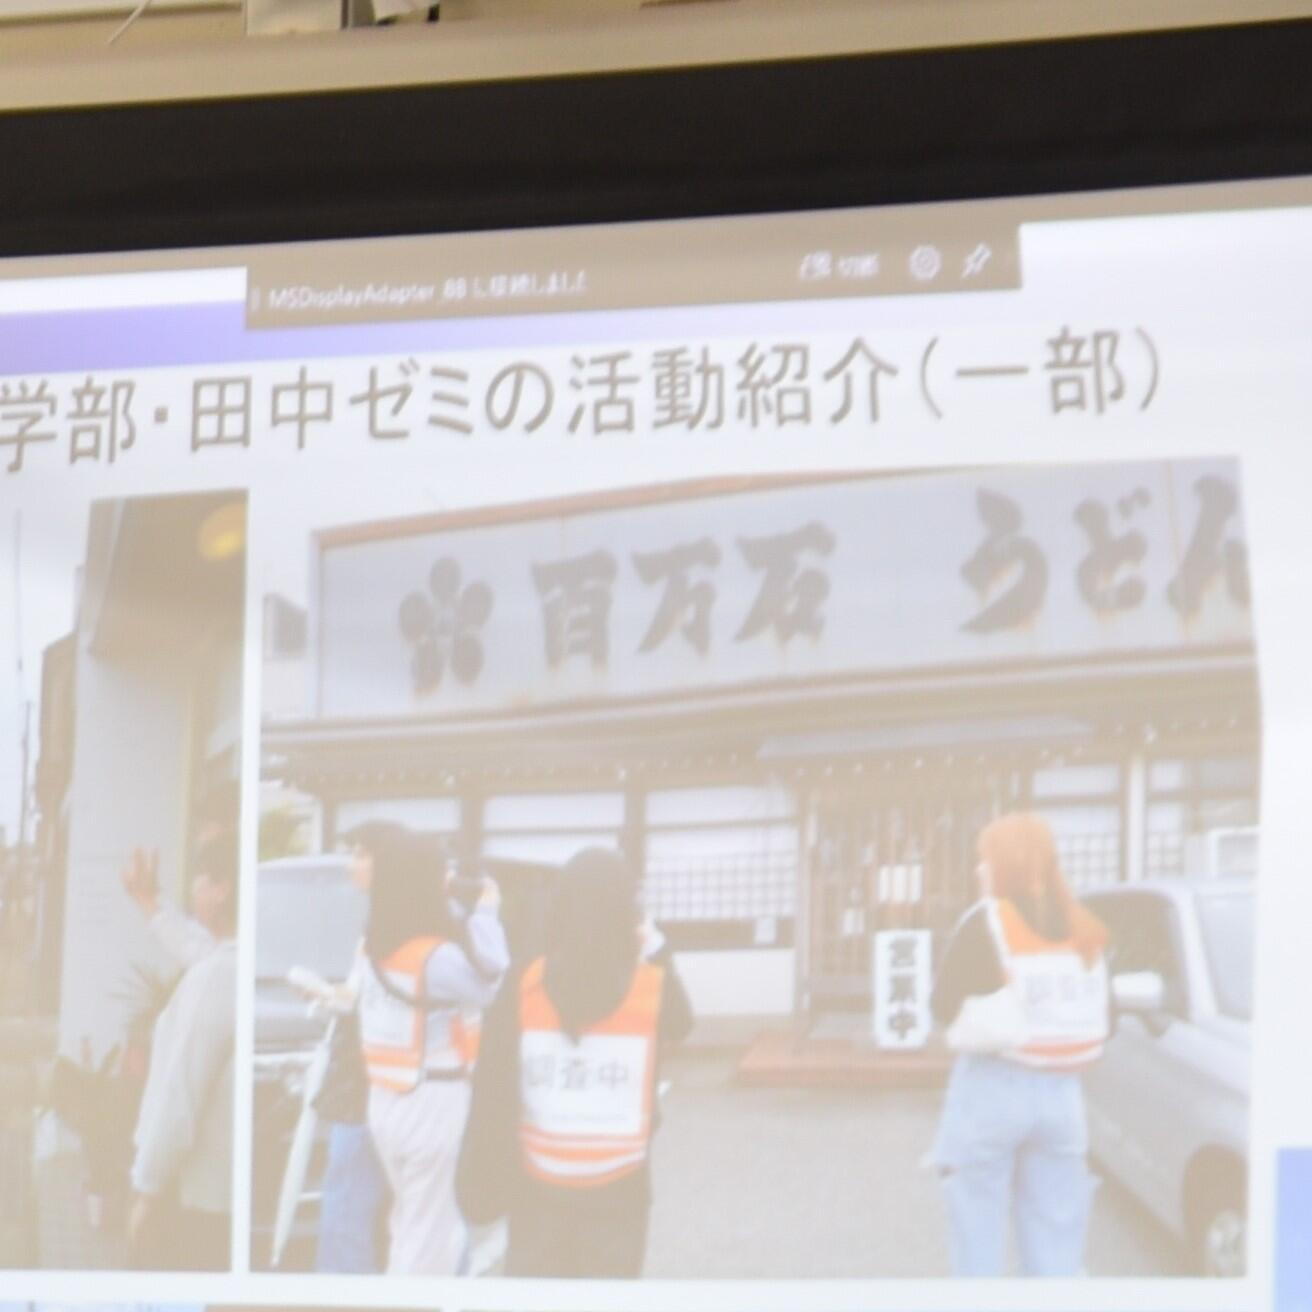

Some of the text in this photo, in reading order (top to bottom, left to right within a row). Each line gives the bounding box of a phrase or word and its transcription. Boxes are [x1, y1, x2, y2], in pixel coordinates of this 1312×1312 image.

[533, 475, 1250, 669] 百万石 うどん
